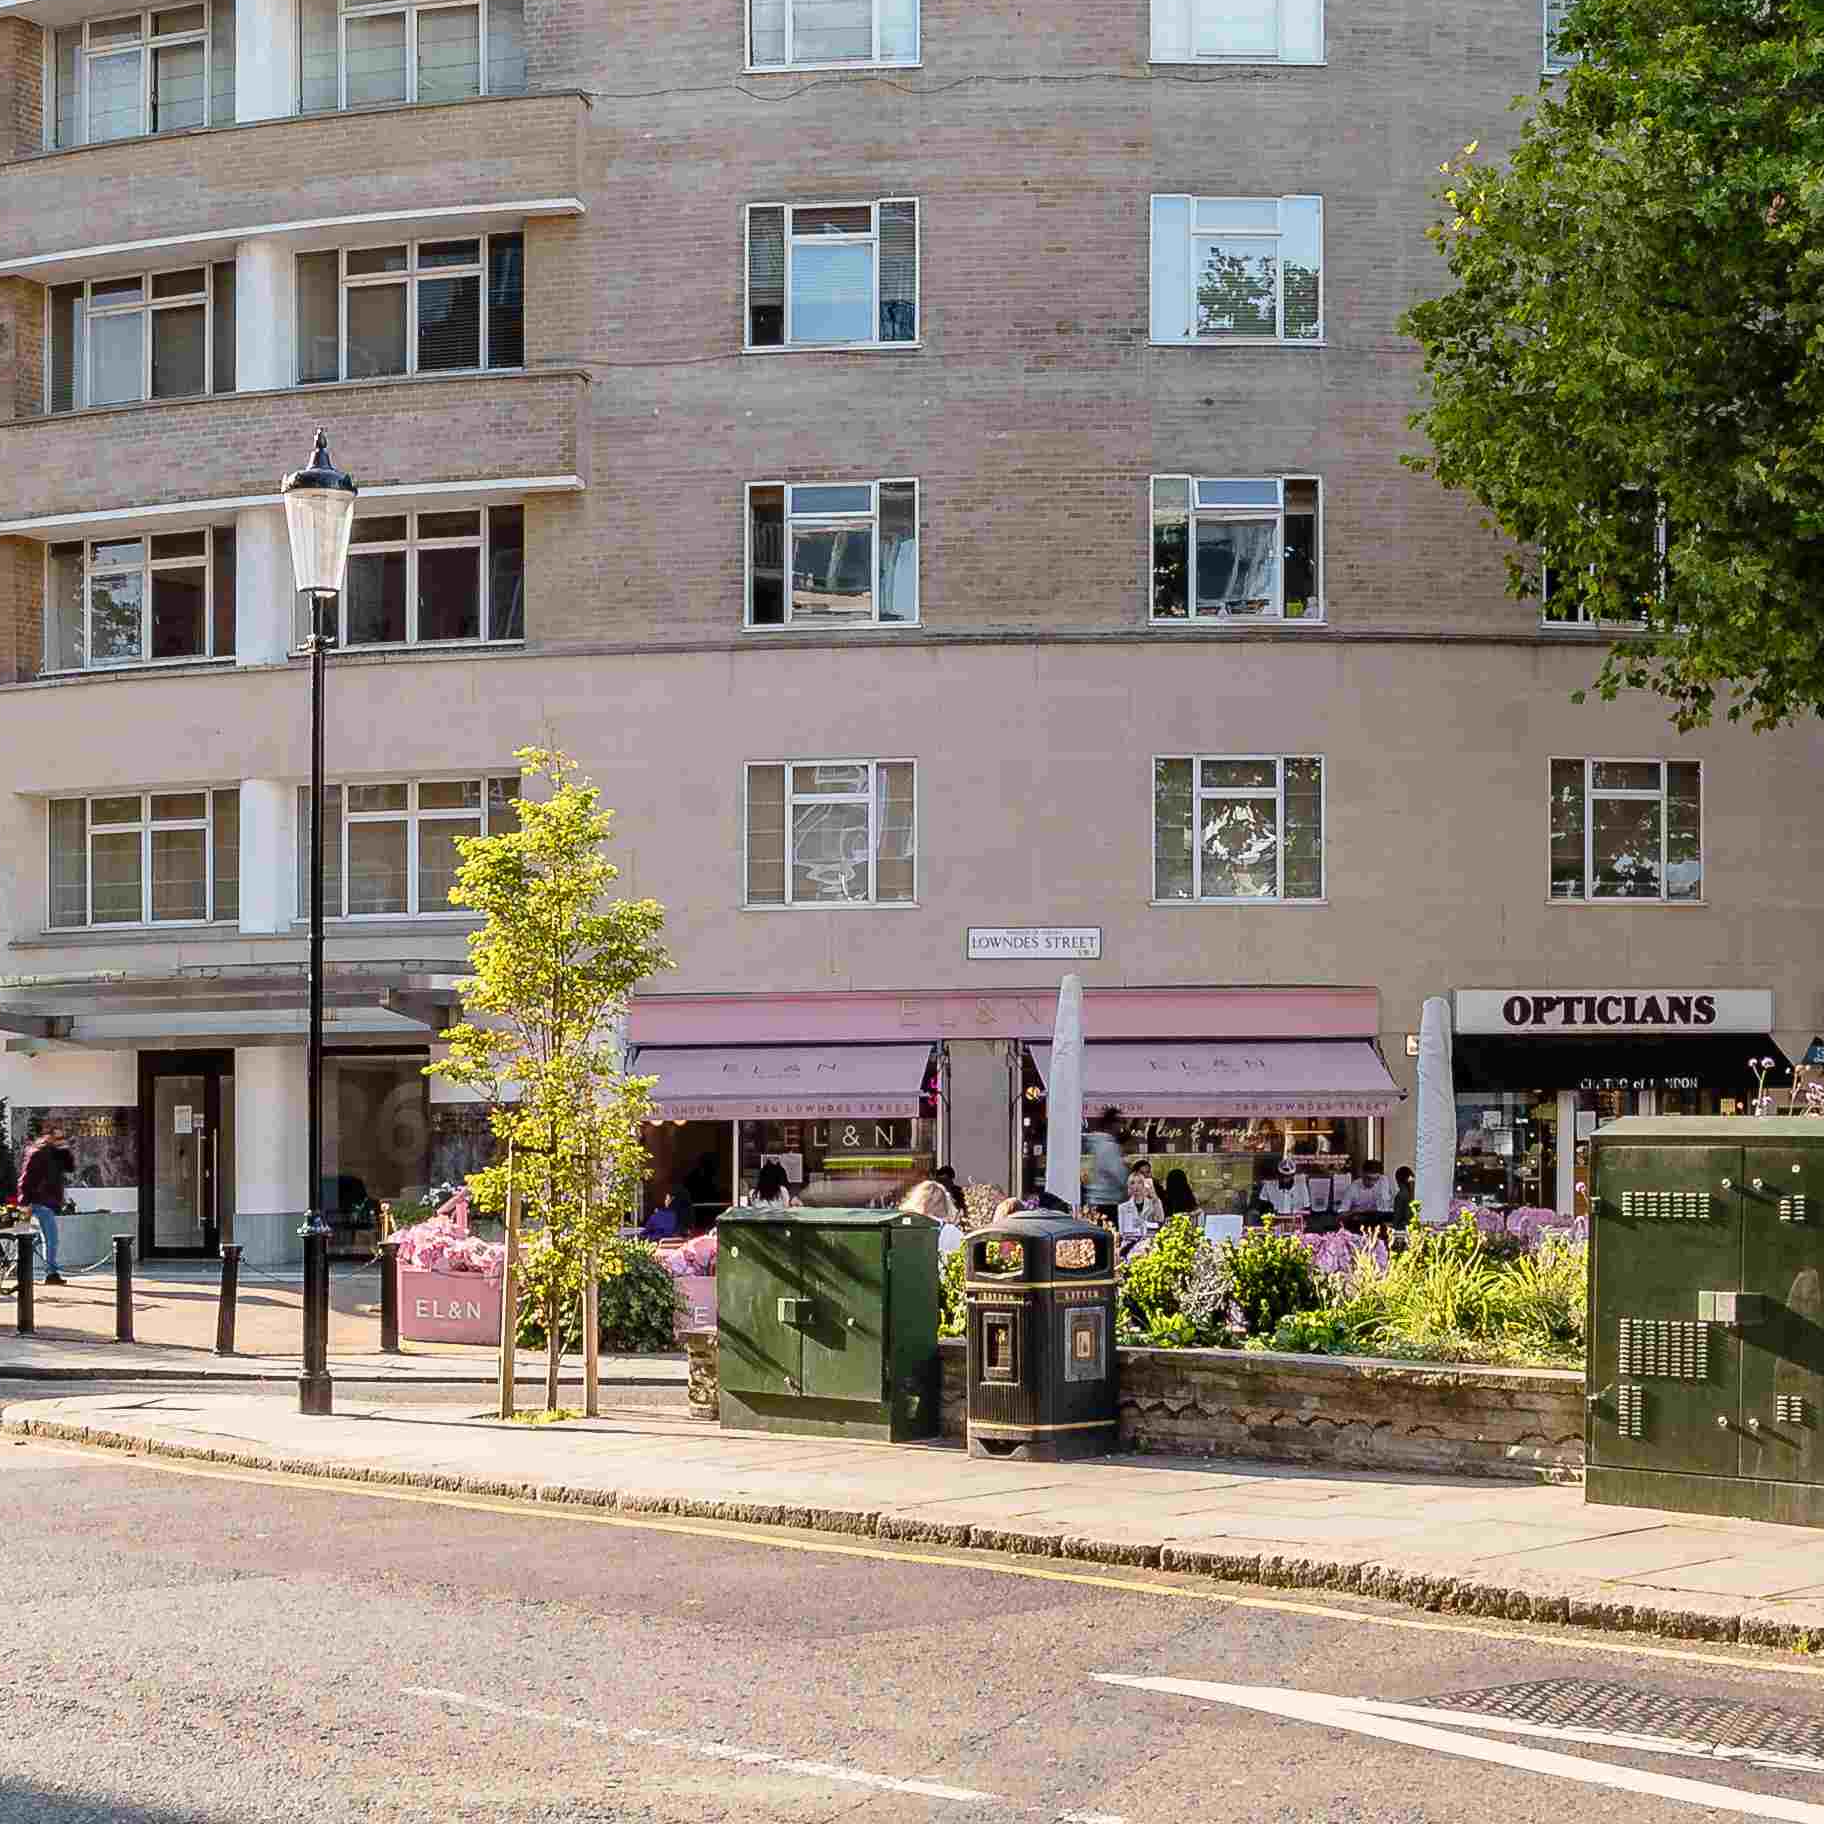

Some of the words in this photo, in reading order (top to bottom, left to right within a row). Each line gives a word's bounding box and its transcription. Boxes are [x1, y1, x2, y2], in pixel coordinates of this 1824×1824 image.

[972, 936, 1039, 949] LOWNDES
[1045, 936, 1096, 949] STREET
[1503, 995, 1717, 1026] OPTICIANS
[415, 1298, 481, 1320] EL&N
